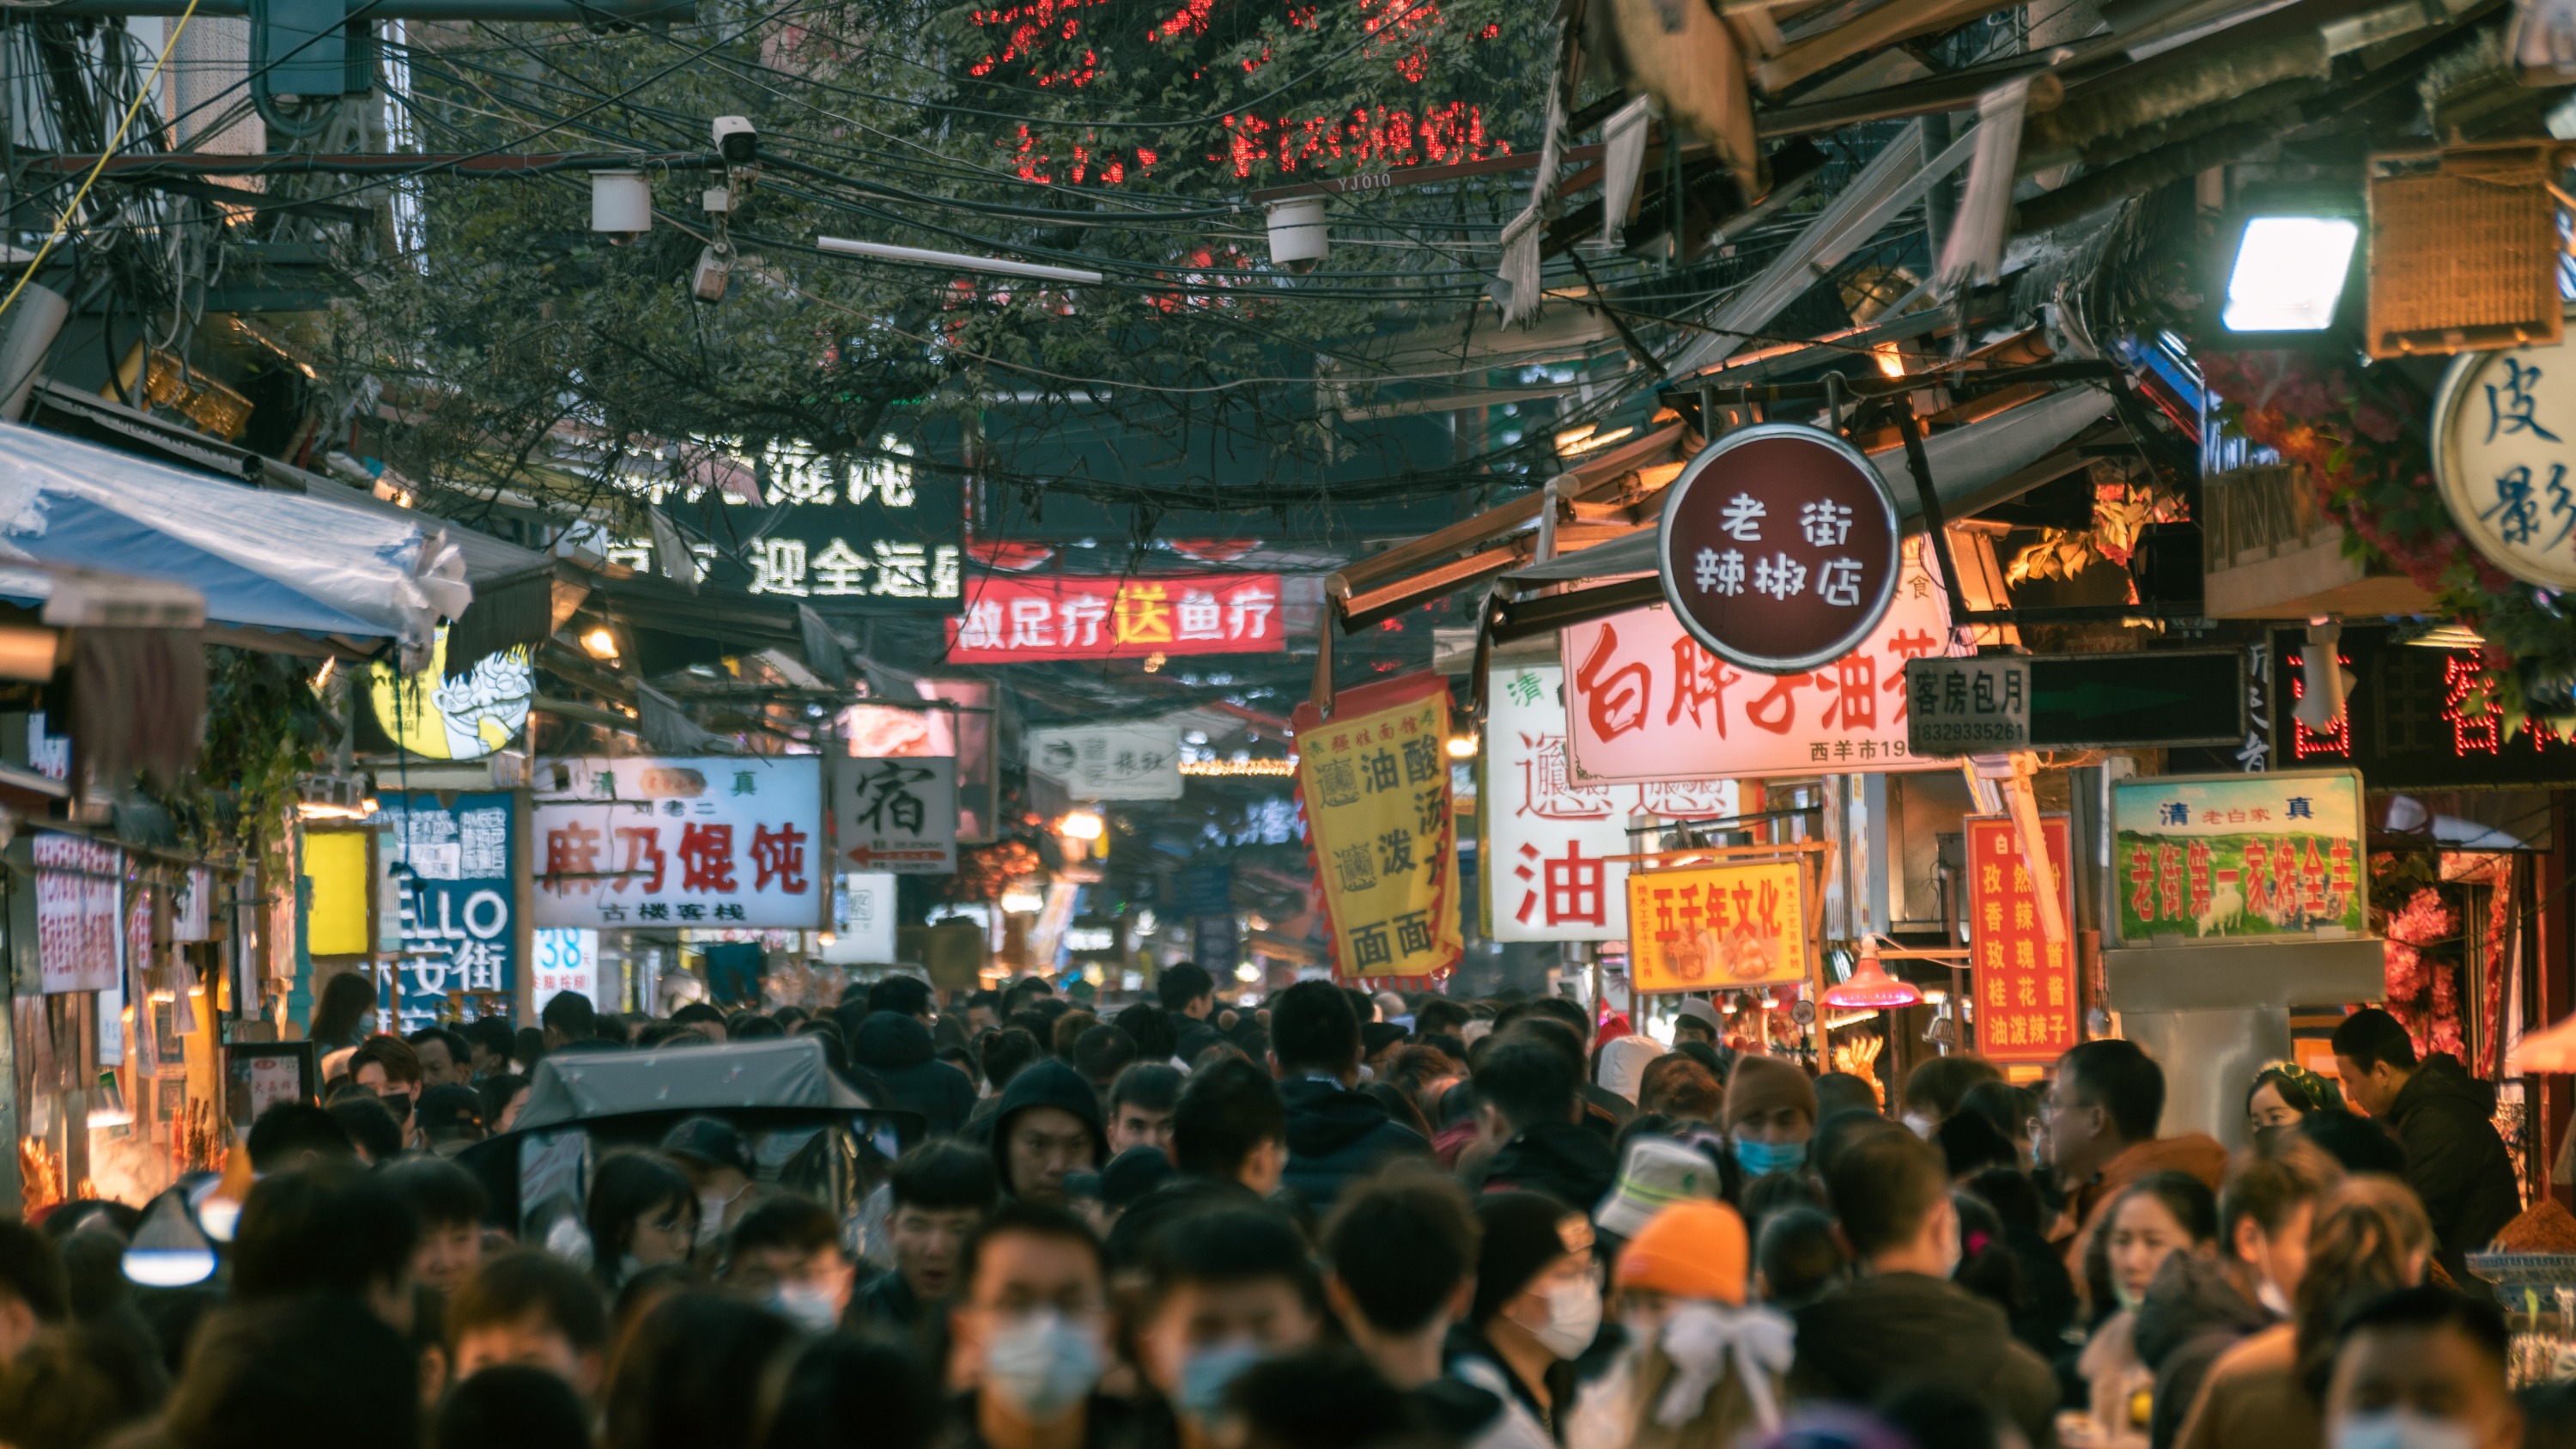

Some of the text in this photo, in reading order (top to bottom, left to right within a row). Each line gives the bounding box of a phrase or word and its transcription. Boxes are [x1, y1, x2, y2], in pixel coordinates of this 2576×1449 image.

[1338, 174, 1391, 192] YJ010
[1720, 492, 1853, 548] 老街
[1694, 547, 1864, 607] 辣椒店
[954, 585, 1276, 650] 做足疗送鱼疗
[1507, 672, 1546, 708] 清
[1915, 669, 2022, 716] 客房包月
[1915, 722, 2023, 742] 18329335261
[591, 770, 618, 798] 清
[731, 770, 758, 796] 真
[856, 761, 935, 835] 宿
[2160, 795, 2314, 826] 清 老白家 真
[543, 819, 810, 895] 麻乃馄饨
[2130, 836, 2354, 922] 老街第一家烤全羊
[1514, 840, 1607, 928] 油
[600, 902, 747, 922] 古楼客栈
[1637, 885, 1653, 978] 桃木工艺十二生肖
[1653, 878, 1783, 944] 五千年文化
[1986, 939, 2064, 971] 玫瑰酱
[1988, 977, 2065, 1008] 桂花酱
[1991, 1015, 2067, 1046] 油泼辣子
